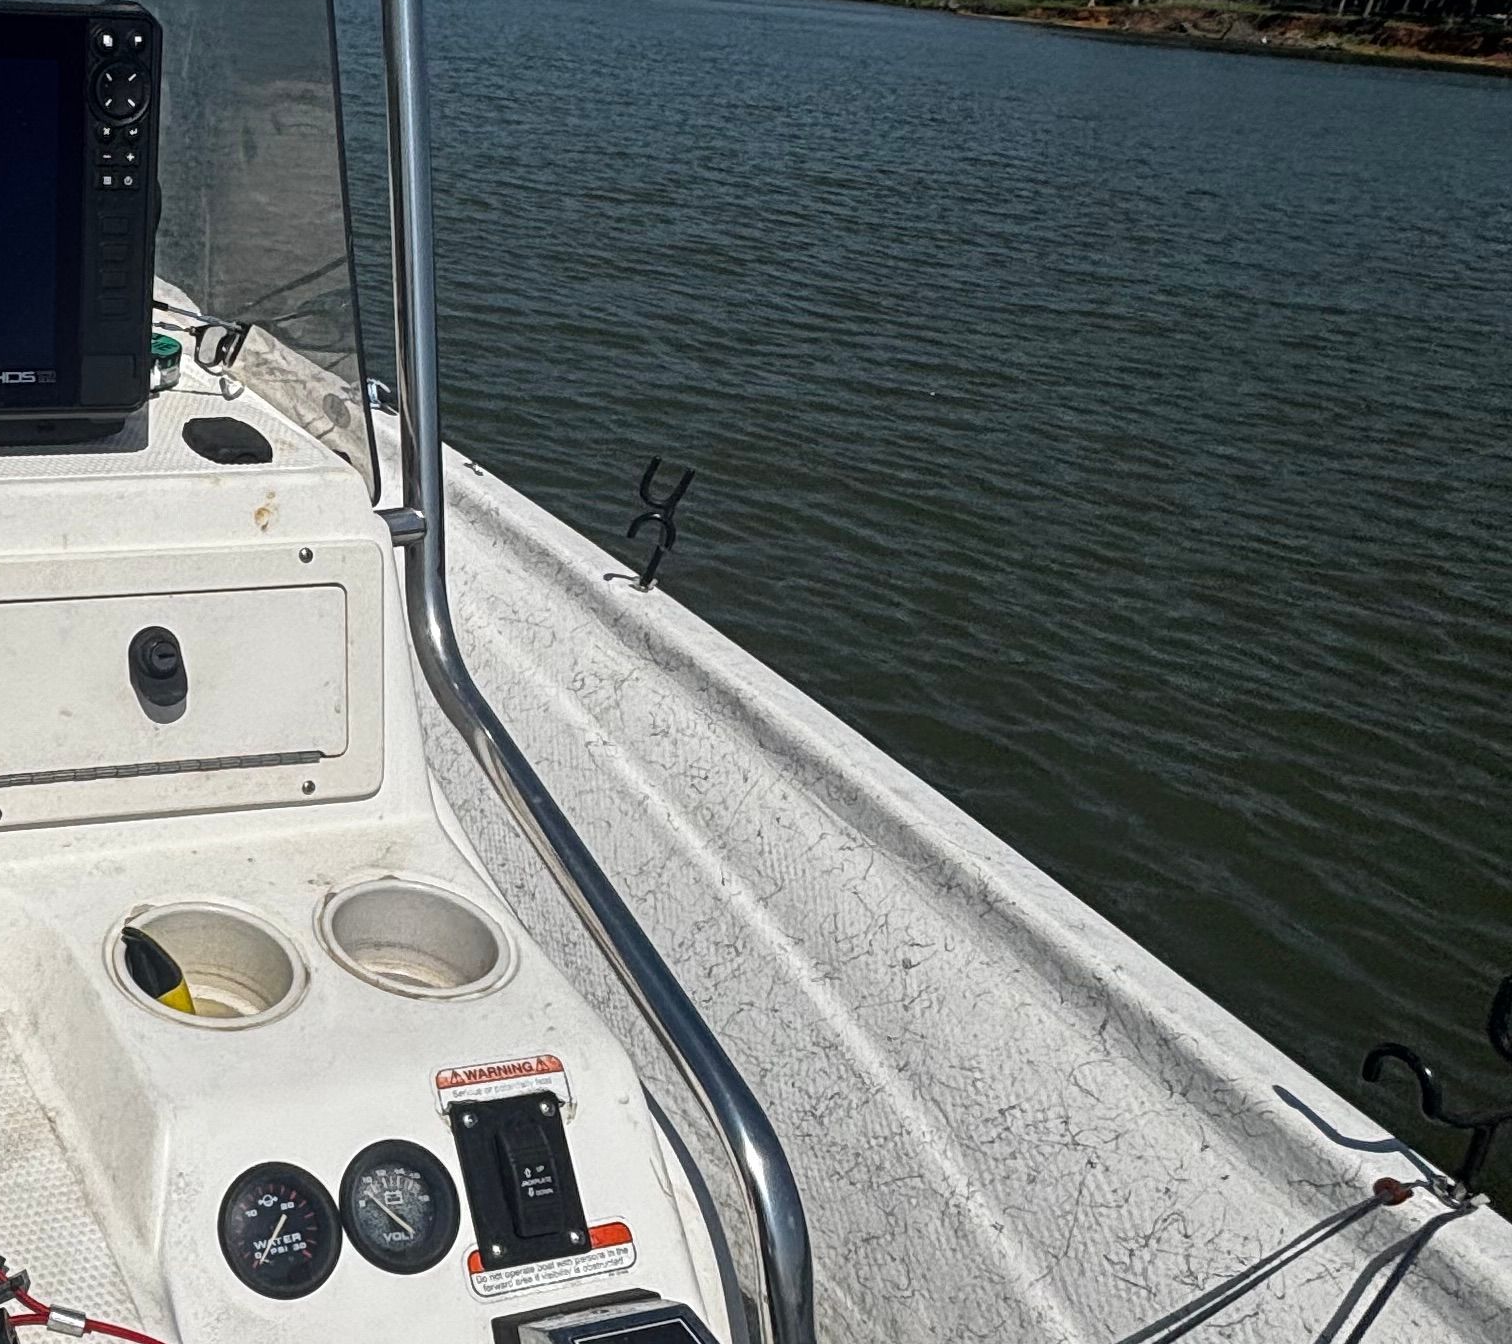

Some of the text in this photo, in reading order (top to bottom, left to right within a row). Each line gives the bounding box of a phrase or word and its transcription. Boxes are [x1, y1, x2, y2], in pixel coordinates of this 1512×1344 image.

[463, 1061, 534, 1081] WARNING
[245, 1209, 257, 1217] 10
[253, 1232, 302, 1250] WATER
[383, 1231, 414, 1243] VOLT
[254, 1251, 262, 1260] 0
[270, 1246, 288, 1256] PSI
[476, 1275, 487, 1285] Do
[616, 1246, 629, 1255] the
